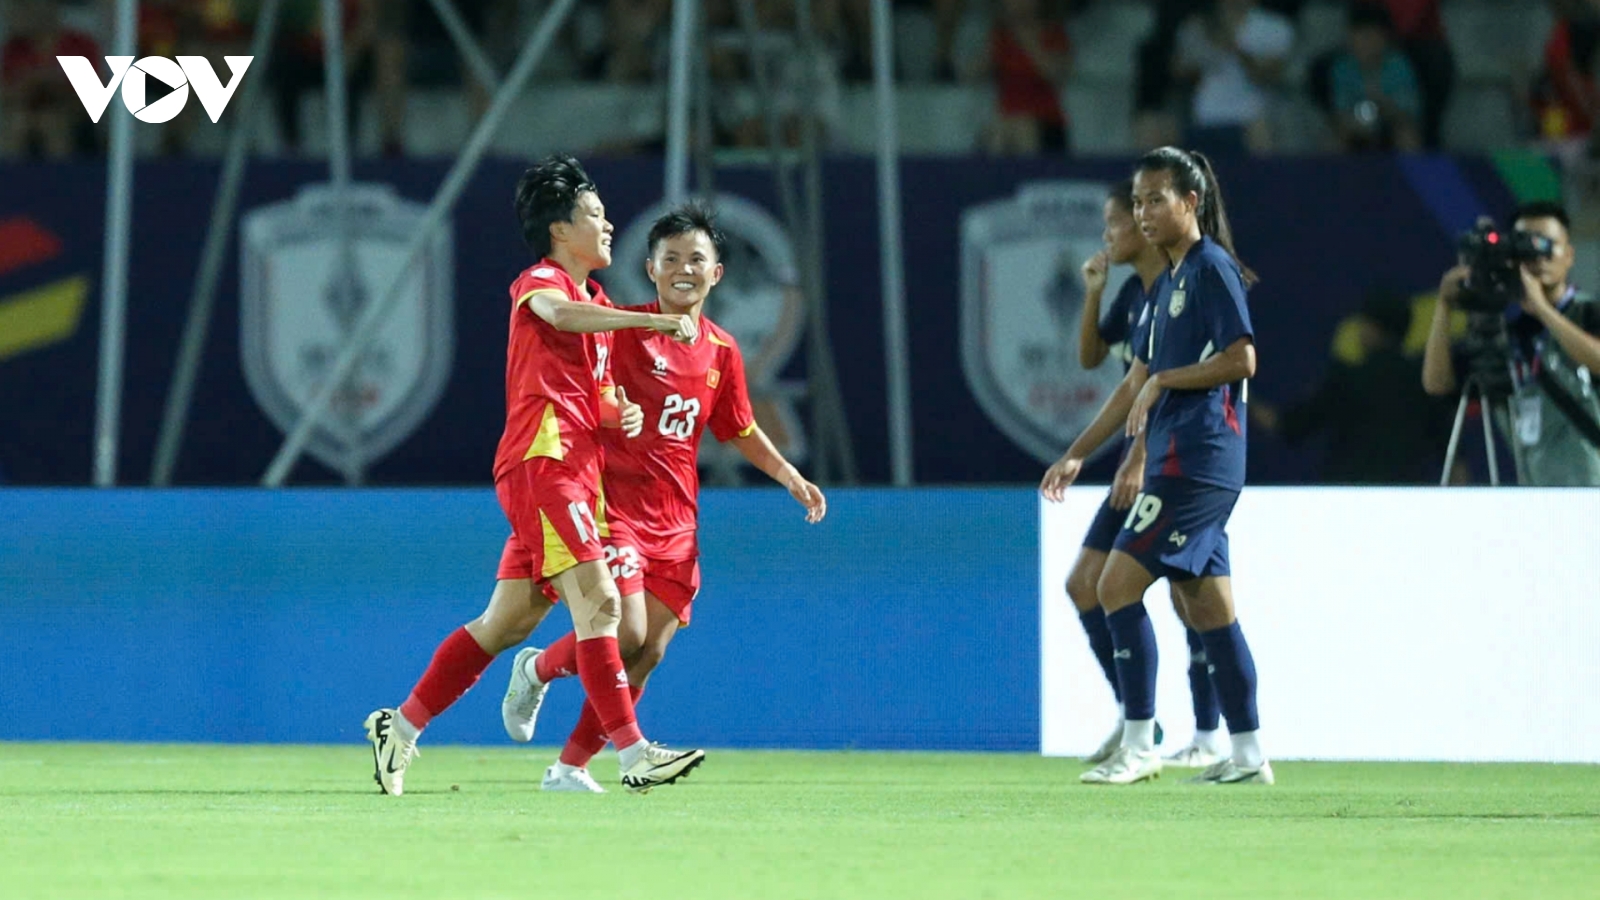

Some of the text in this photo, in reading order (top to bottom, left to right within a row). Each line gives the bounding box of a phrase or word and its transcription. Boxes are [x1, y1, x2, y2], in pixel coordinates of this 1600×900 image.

[658, 393, 701, 439] 23
[1124, 492, 1163, 533] 19
[601, 544, 640, 579] 23
